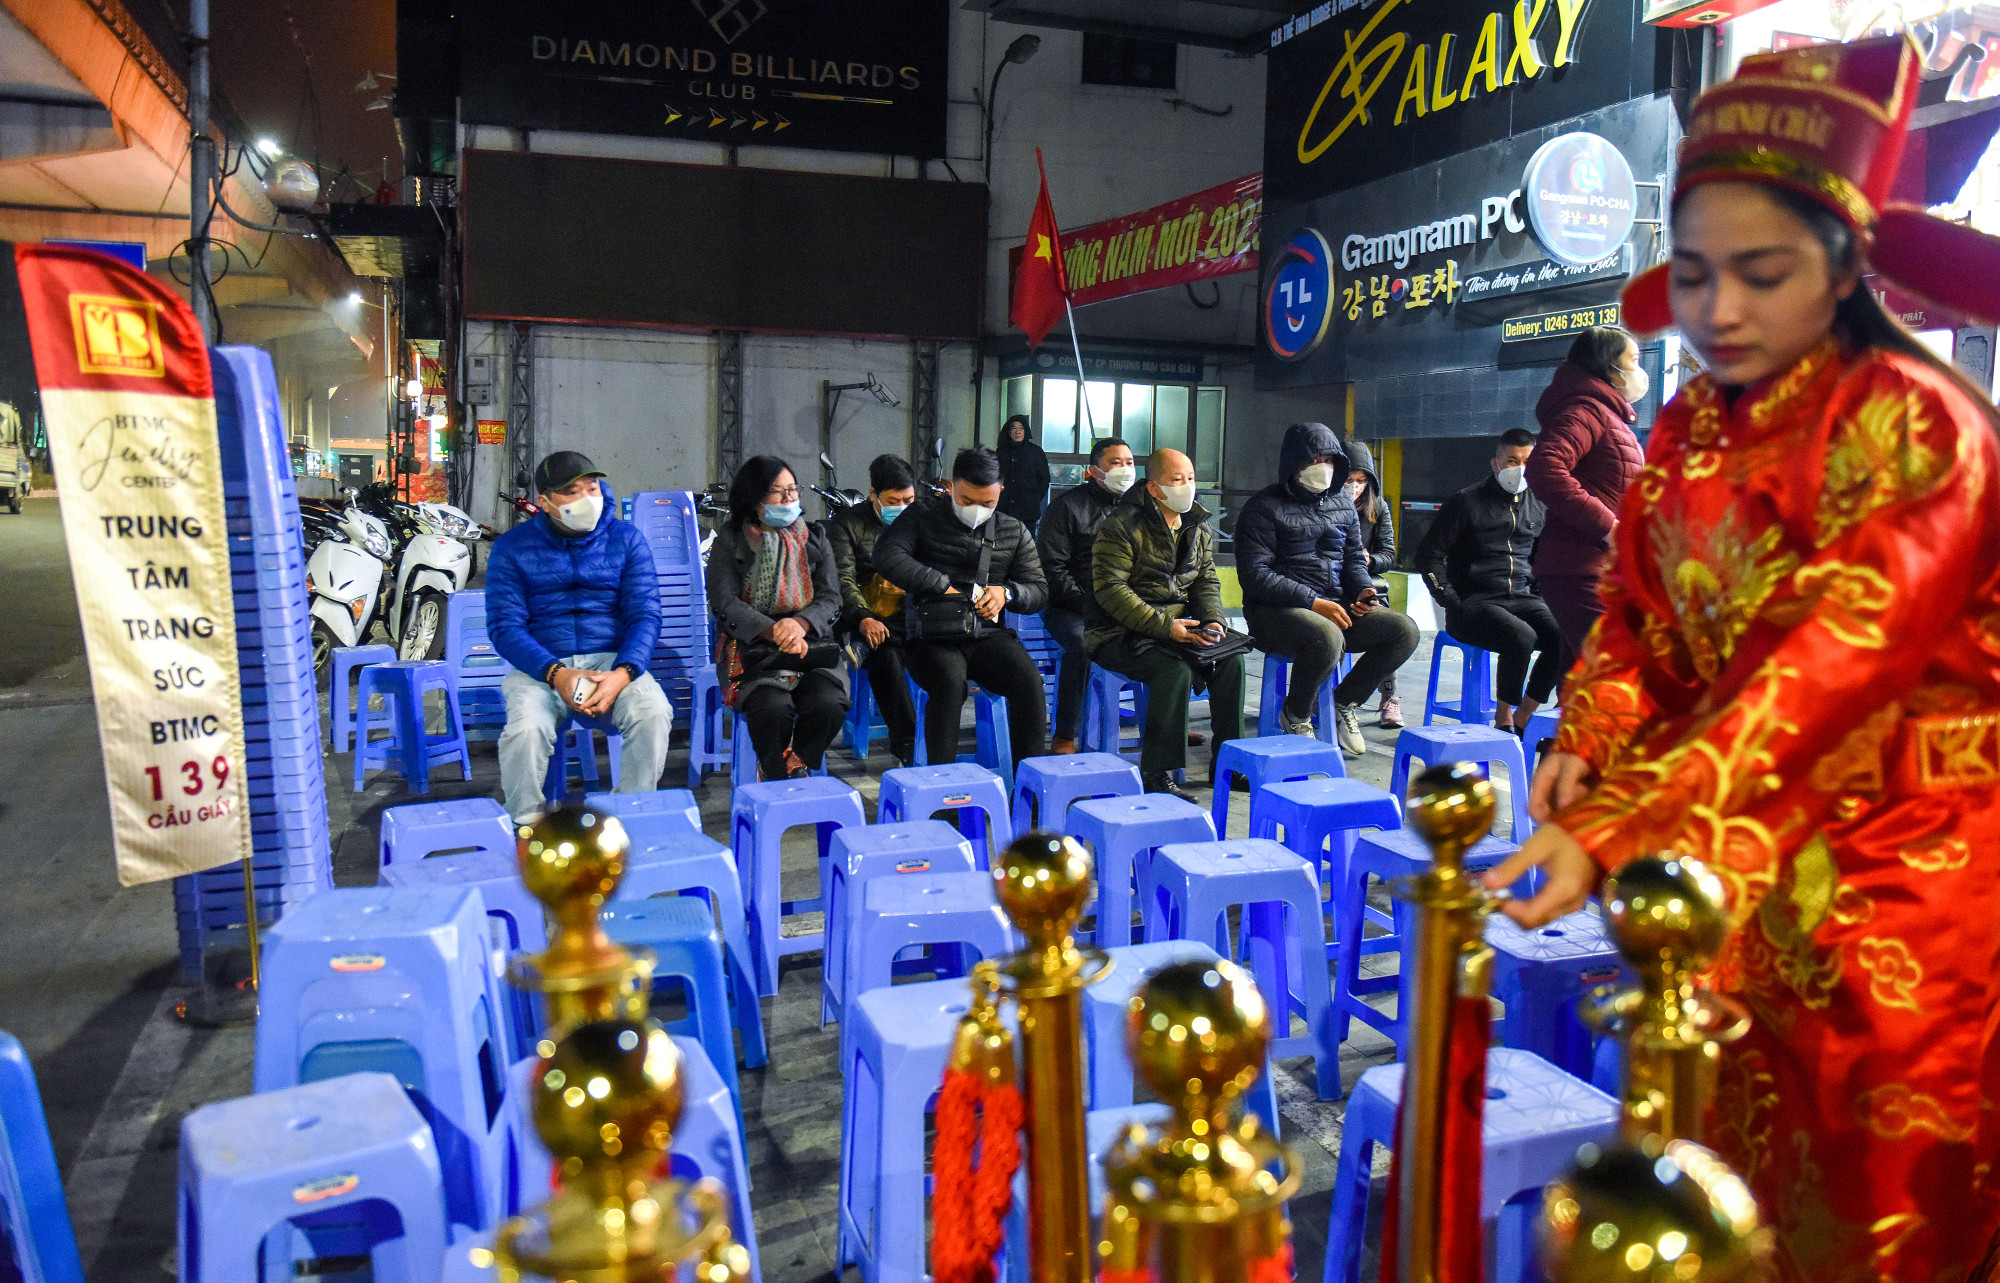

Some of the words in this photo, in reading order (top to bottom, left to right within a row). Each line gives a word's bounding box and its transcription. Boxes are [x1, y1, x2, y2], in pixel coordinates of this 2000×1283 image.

[531, 35, 717, 73] DIAMOND
[731, 52, 921, 90] BILLIARDS
[689, 80, 756, 101] CLUB
[1298, 0, 1586, 164] GALAXY
[1064, 237, 1104, 290] ỪNG
[1102, 220, 1154, 283] NĂM
[1153, 203, 1204, 271] MỚI
[1341, 214, 1476, 272] Gangnam
[1465, 276, 1489, 294] Thiên
[1491, 272, 1520, 293] đường
[1505, 319, 1543, 337] Delivery:
[1544, 314, 1568, 332] 0246
[1570, 311, 1595, 329] 2933
[1598, 306, 1617, 325] 139
[1058, 355, 1082, 367] CÔN
[121, 476, 176, 490] CENTER
[100, 515, 203, 539] TRUNG
[127, 560, 189, 590] TÂM
[122, 616, 214, 641] TRANG
[154, 661, 205, 691] SỨC
[150, 714, 219, 745] BTMC
